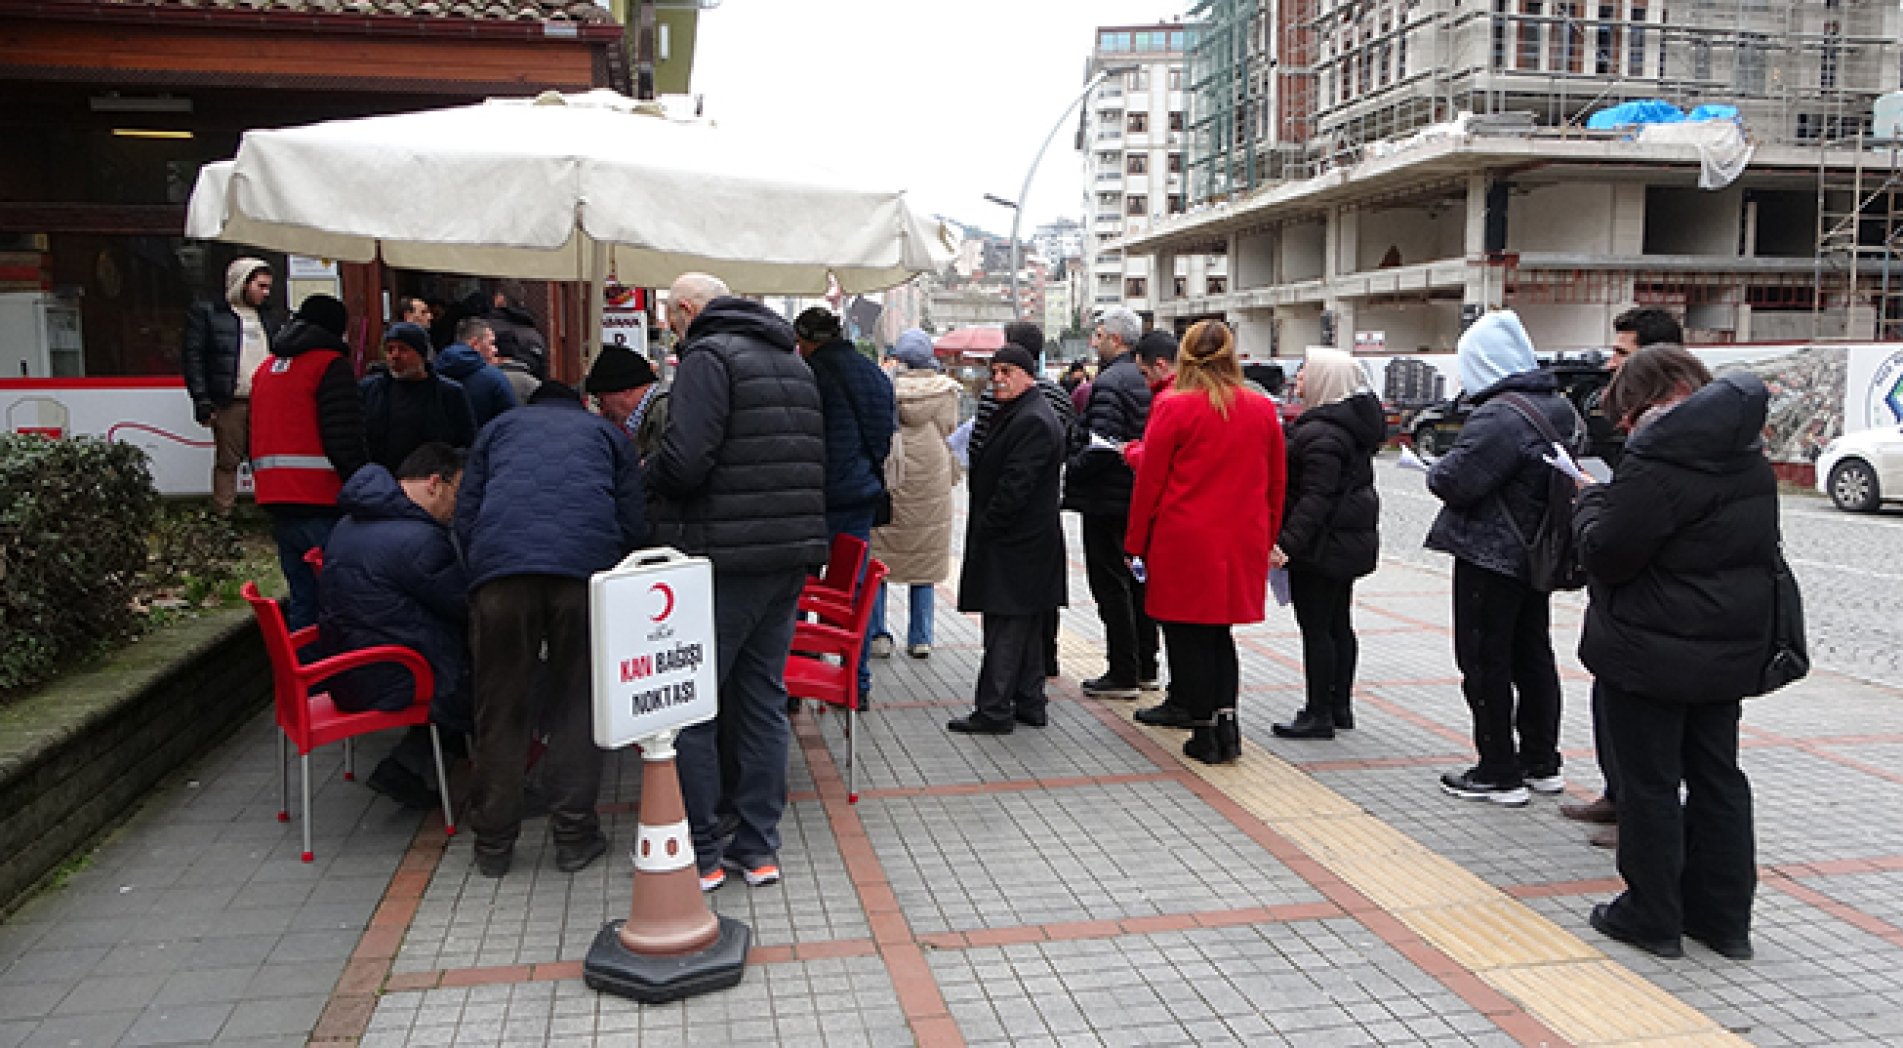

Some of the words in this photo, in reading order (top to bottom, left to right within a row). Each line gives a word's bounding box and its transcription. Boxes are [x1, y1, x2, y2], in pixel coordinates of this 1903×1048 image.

[620, 656, 653, 682] KAN
[656, 641, 703, 672] BAĞIŞI
[632, 679, 697, 716] NOKTASI
